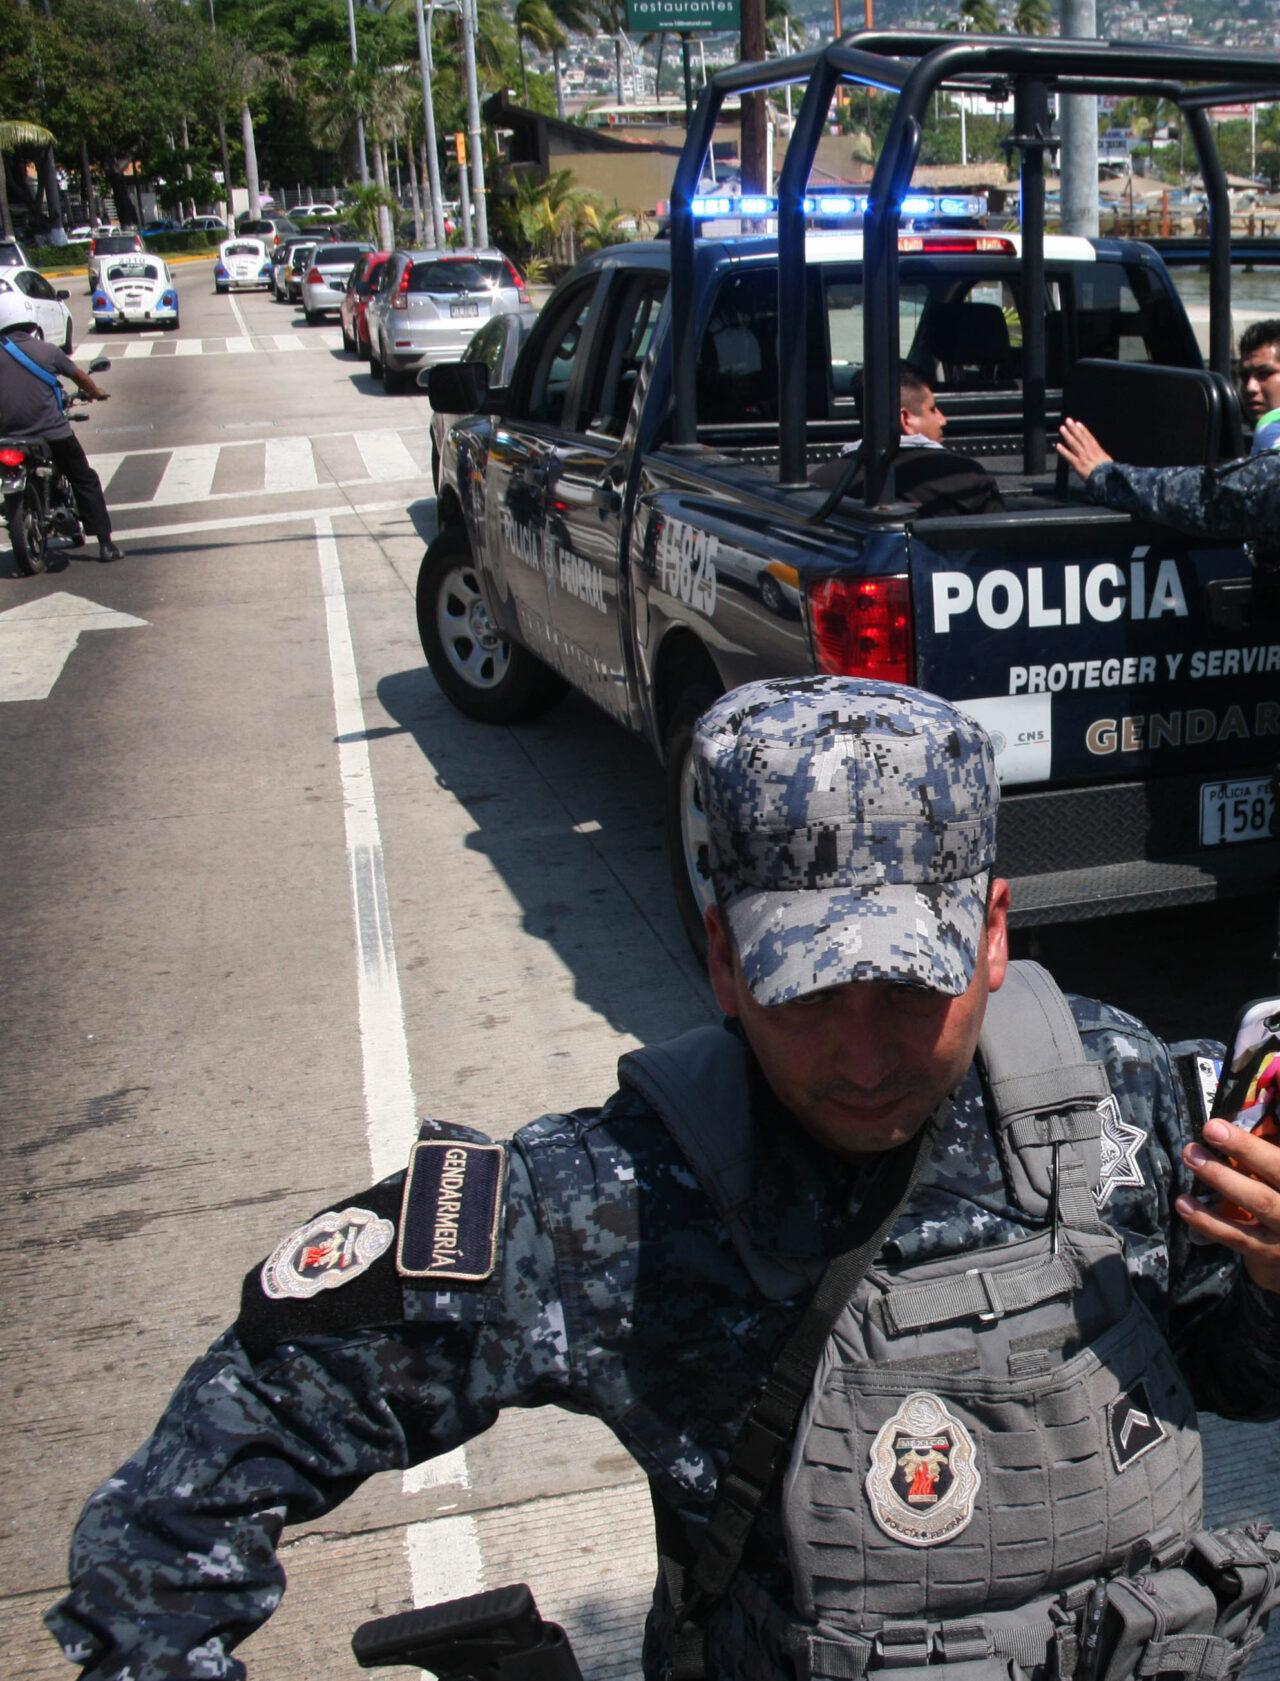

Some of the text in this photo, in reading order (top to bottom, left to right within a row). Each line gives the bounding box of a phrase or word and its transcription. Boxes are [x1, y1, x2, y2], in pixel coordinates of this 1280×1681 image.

[633, 0, 733, 12] restaurantes
[661, 514, 719, 617] 15825
[931, 545, 1189, 634] POLICÍA
[1009, 656, 1157, 695] PROTEGER
[1167, 653, 1184, 681] Y
[1017, 730, 1045, 742] CNS
[1217, 796, 1275, 836] 158
[431, 1148, 468, 1268] GENDARMERÍA
